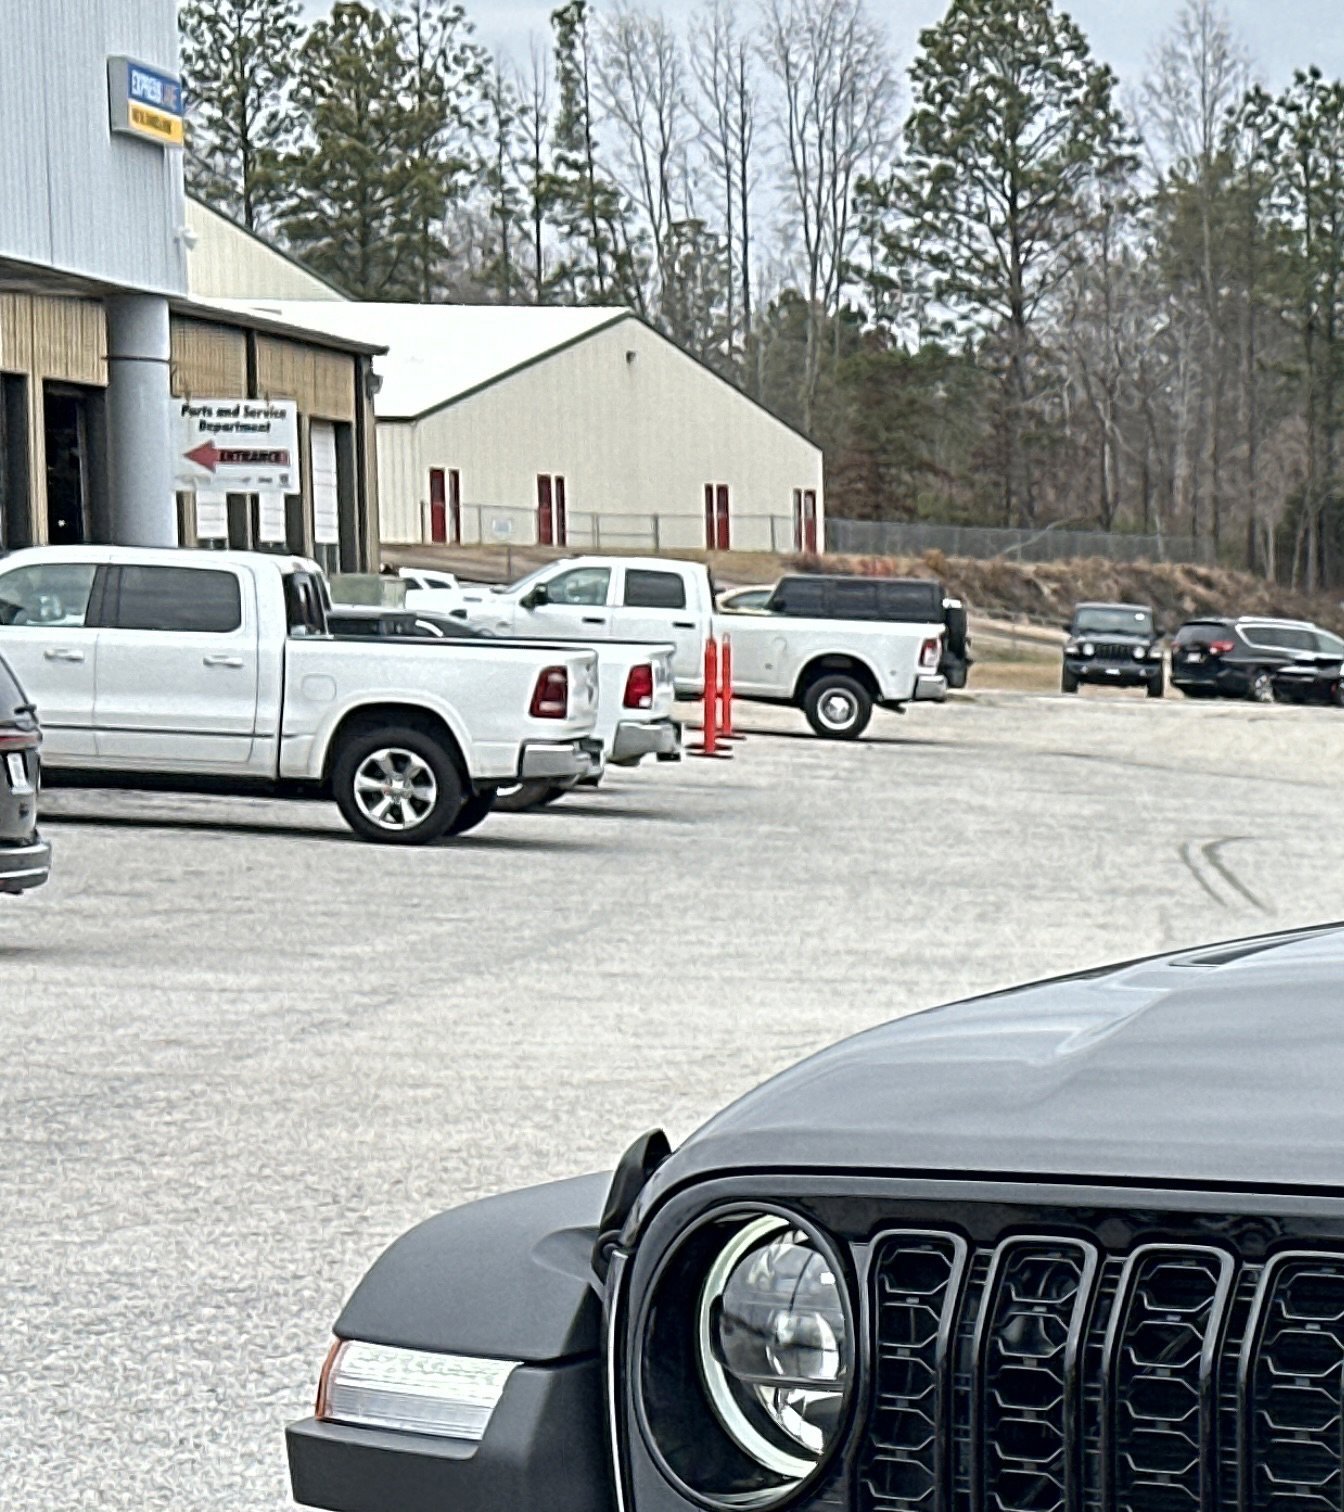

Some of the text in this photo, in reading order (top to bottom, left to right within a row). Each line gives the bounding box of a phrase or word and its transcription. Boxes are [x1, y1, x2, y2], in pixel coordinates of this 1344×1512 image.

[181, 404, 287, 419] Parts and Service
[198, 419, 272, 435] Department
[219, 450, 284, 463] ENTRANCE
